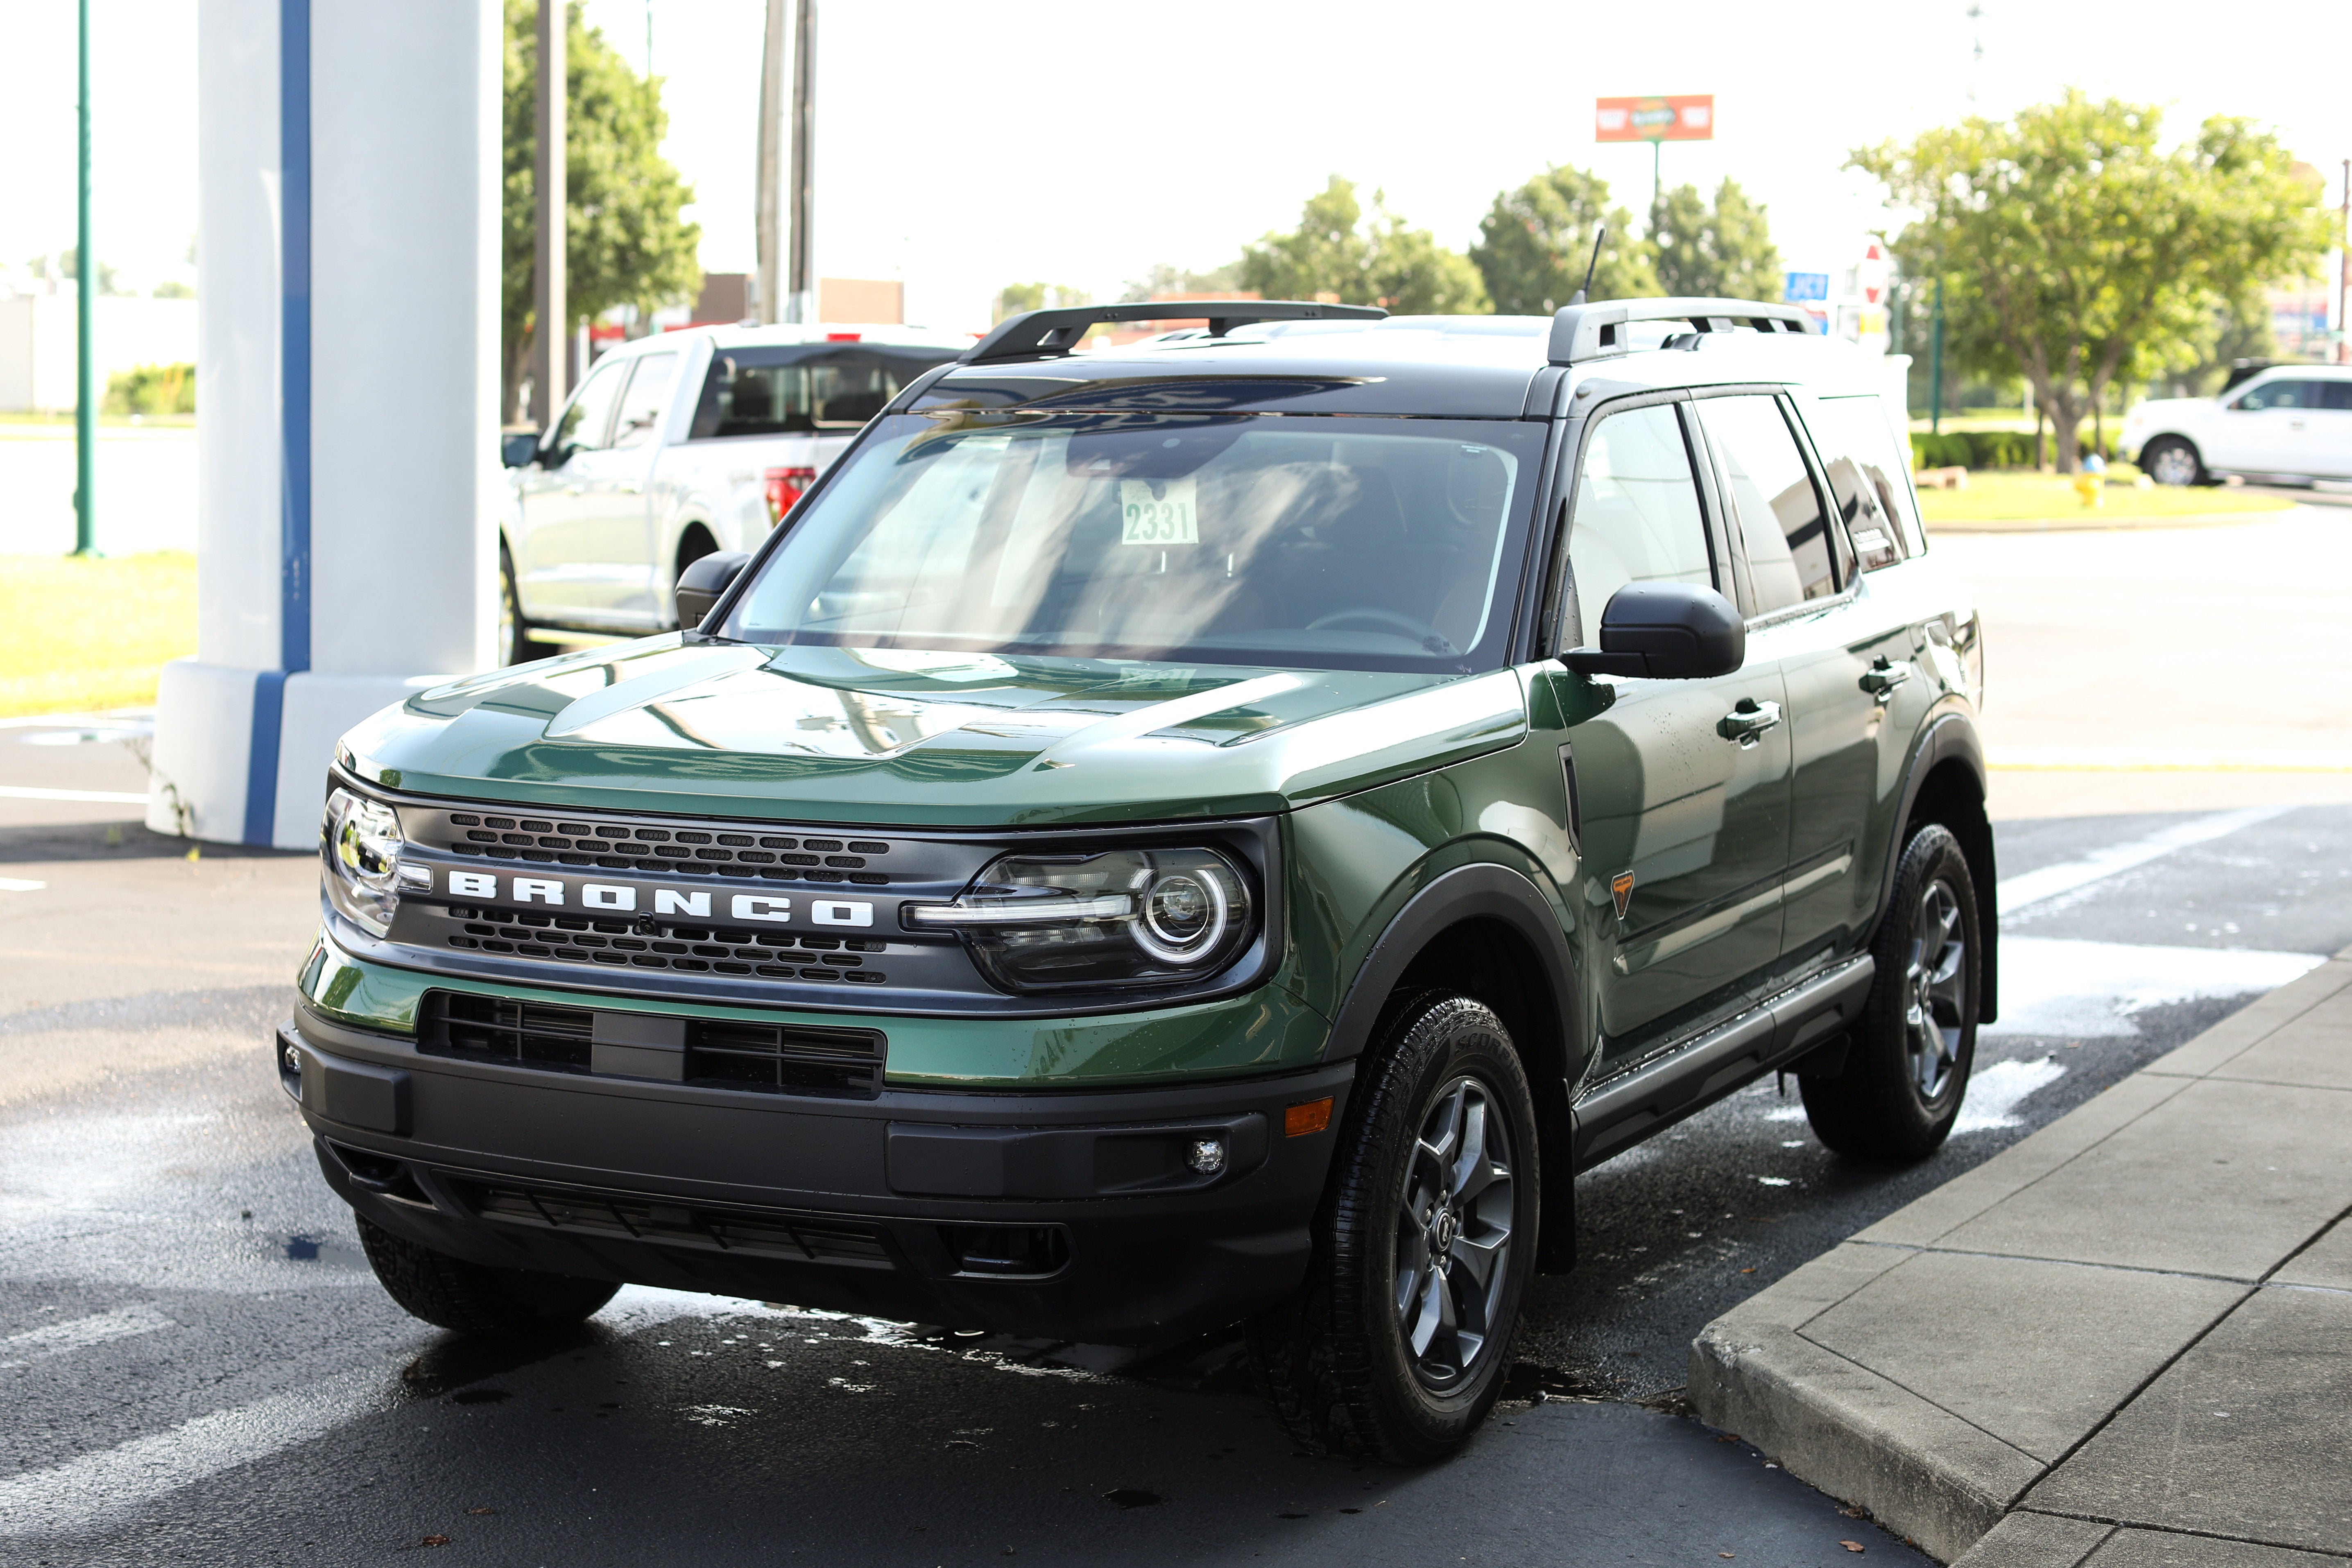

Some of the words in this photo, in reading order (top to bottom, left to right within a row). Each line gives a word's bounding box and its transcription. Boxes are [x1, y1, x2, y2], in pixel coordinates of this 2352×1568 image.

[1126, 502, 1188, 540] 2331
[448, 870, 874, 927] BRONCO
[1454, 1032, 1530, 1105] SCORPION
[1390, 1125, 1413, 1202] PIRELLI
[1501, 1312, 1525, 1377] PIRELLI
[1396, 1372, 1460, 1433] PIRELLI
